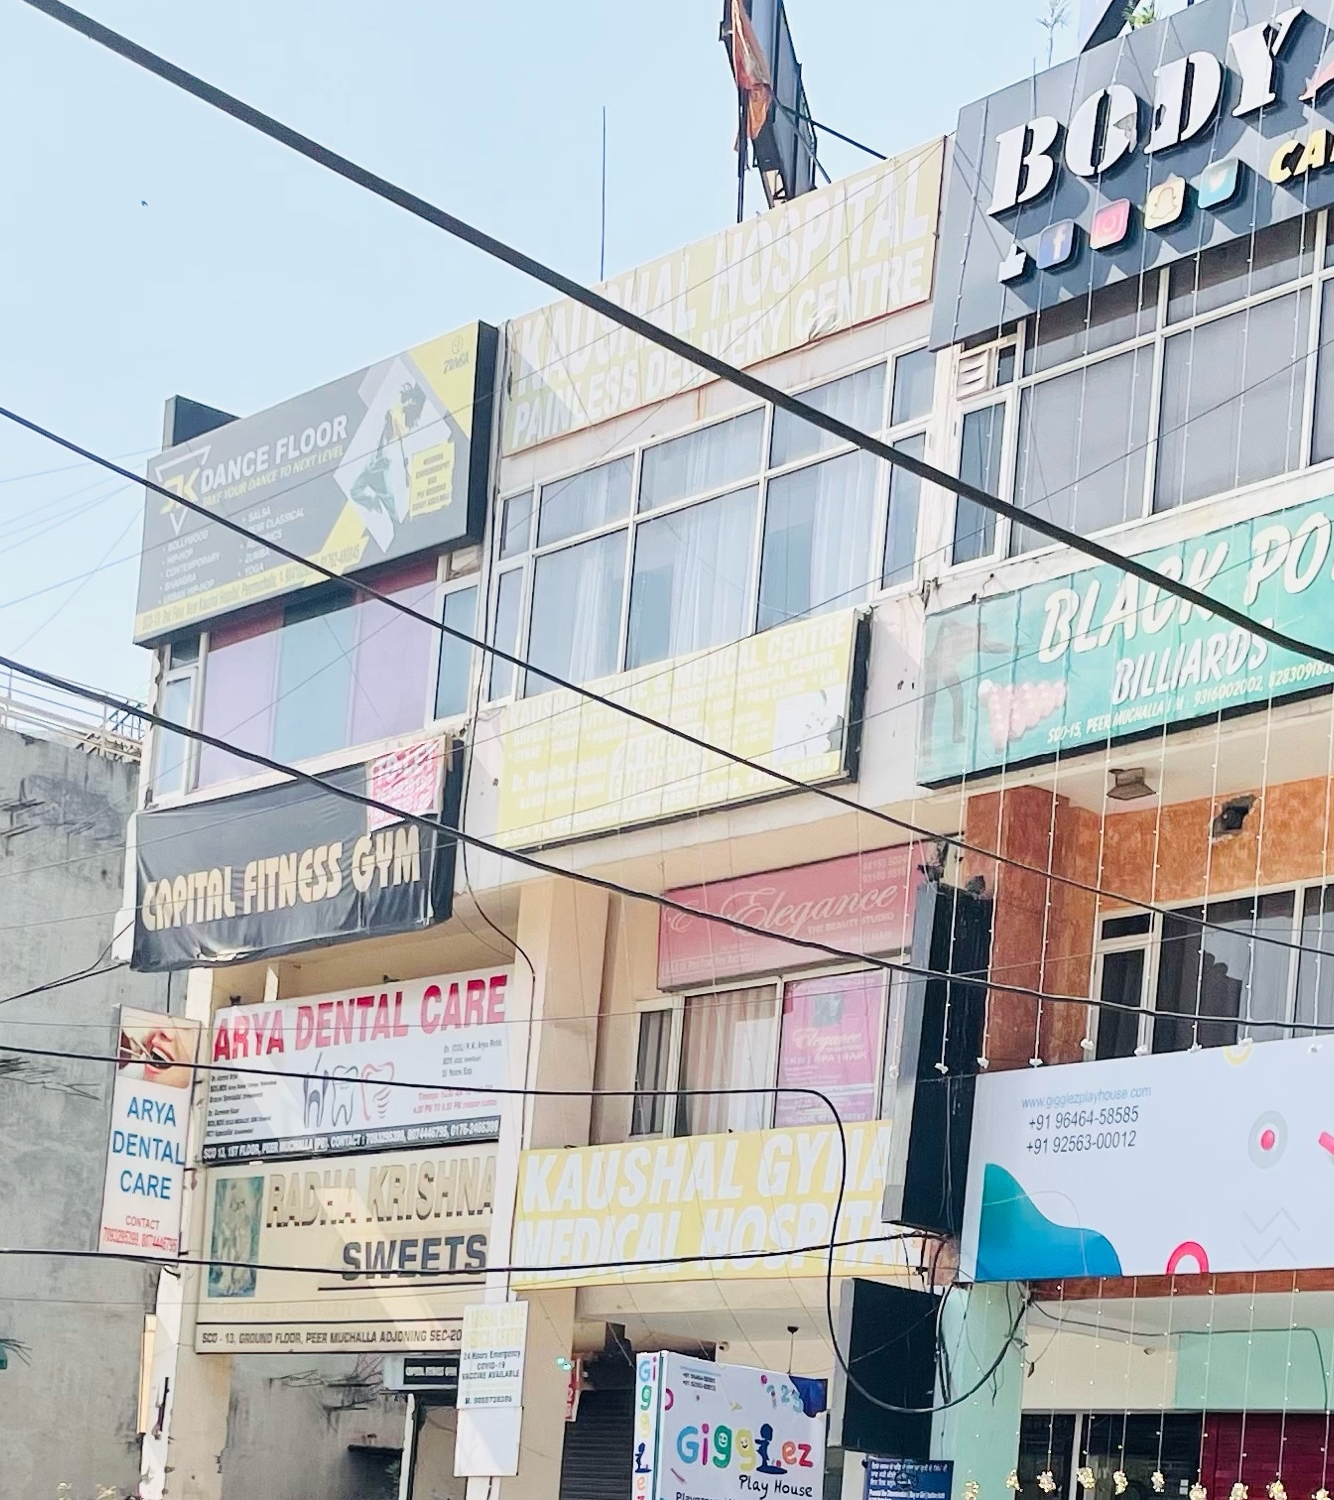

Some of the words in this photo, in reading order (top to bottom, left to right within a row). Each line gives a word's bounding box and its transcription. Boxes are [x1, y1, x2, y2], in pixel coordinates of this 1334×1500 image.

[987, 6, 1306, 216] BODY
[516, 255, 697, 395] KAUSHAL
[709, 156, 930, 320] HOSPITAL
[510, 361, 637, 447] PAINLESS
[796, 245, 926, 341] CENTRE
[202, 440, 270, 494] DANCE
[275, 414, 349, 465] FLOOR
[248, 471, 278, 491] DANCE
[293, 455, 316, 477] NEXT
[317, 445, 344, 466] LEVEL
[1038, 542, 1229, 664] BLACK
[1110, 619, 1274, 706] BILLIARDS
[244, 842, 343, 914] FITNESS
[352, 824, 420, 893] GYM
[720, 885, 898, 937] Elegance
[826, 918, 859, 932] BEAUTY
[214, 1009, 284, 1062] ARYA
[295, 991, 408, 1050] DENTAL
[421, 974, 508, 1034] CARE
[127, 1096, 177, 1127] ARYA
[1021, 1085, 1152, 1111] www.gigglezplayhouse.com
[1029, 1114, 1052, 1131] +91
[1055, 1105, 1139, 1129] 96464-58585
[112, 1130, 185, 1166] DENTAL
[1026, 1138, 1049, 1155] +91
[1053, 1130, 1137, 1153] 92563-00012
[119, 1170, 172, 1200] CARE
[267, 1168, 357, 1228] RADHA
[366, 1155, 496, 1223] KRISHNA
[523, 1139, 743, 1213] KAUSHAL
[757, 1130, 893, 1197] GYNA
[125, 1215, 160, 1231] CONTACT
[515, 1212, 682, 1281] MEDICAL
[342, 1234, 487, 1281] SWEETS
[239, 1332, 272, 1345] GROUND
[306, 1331, 328, 1344] PEER
[330, 1330, 377, 1343] MUCHALLA
[430, 1328, 463, 1342] SEC-20
[477, 1360, 506, 1371] COVID-19
[739, 1474, 769, 1500] Play
[774, 1479, 813, 1498] House
